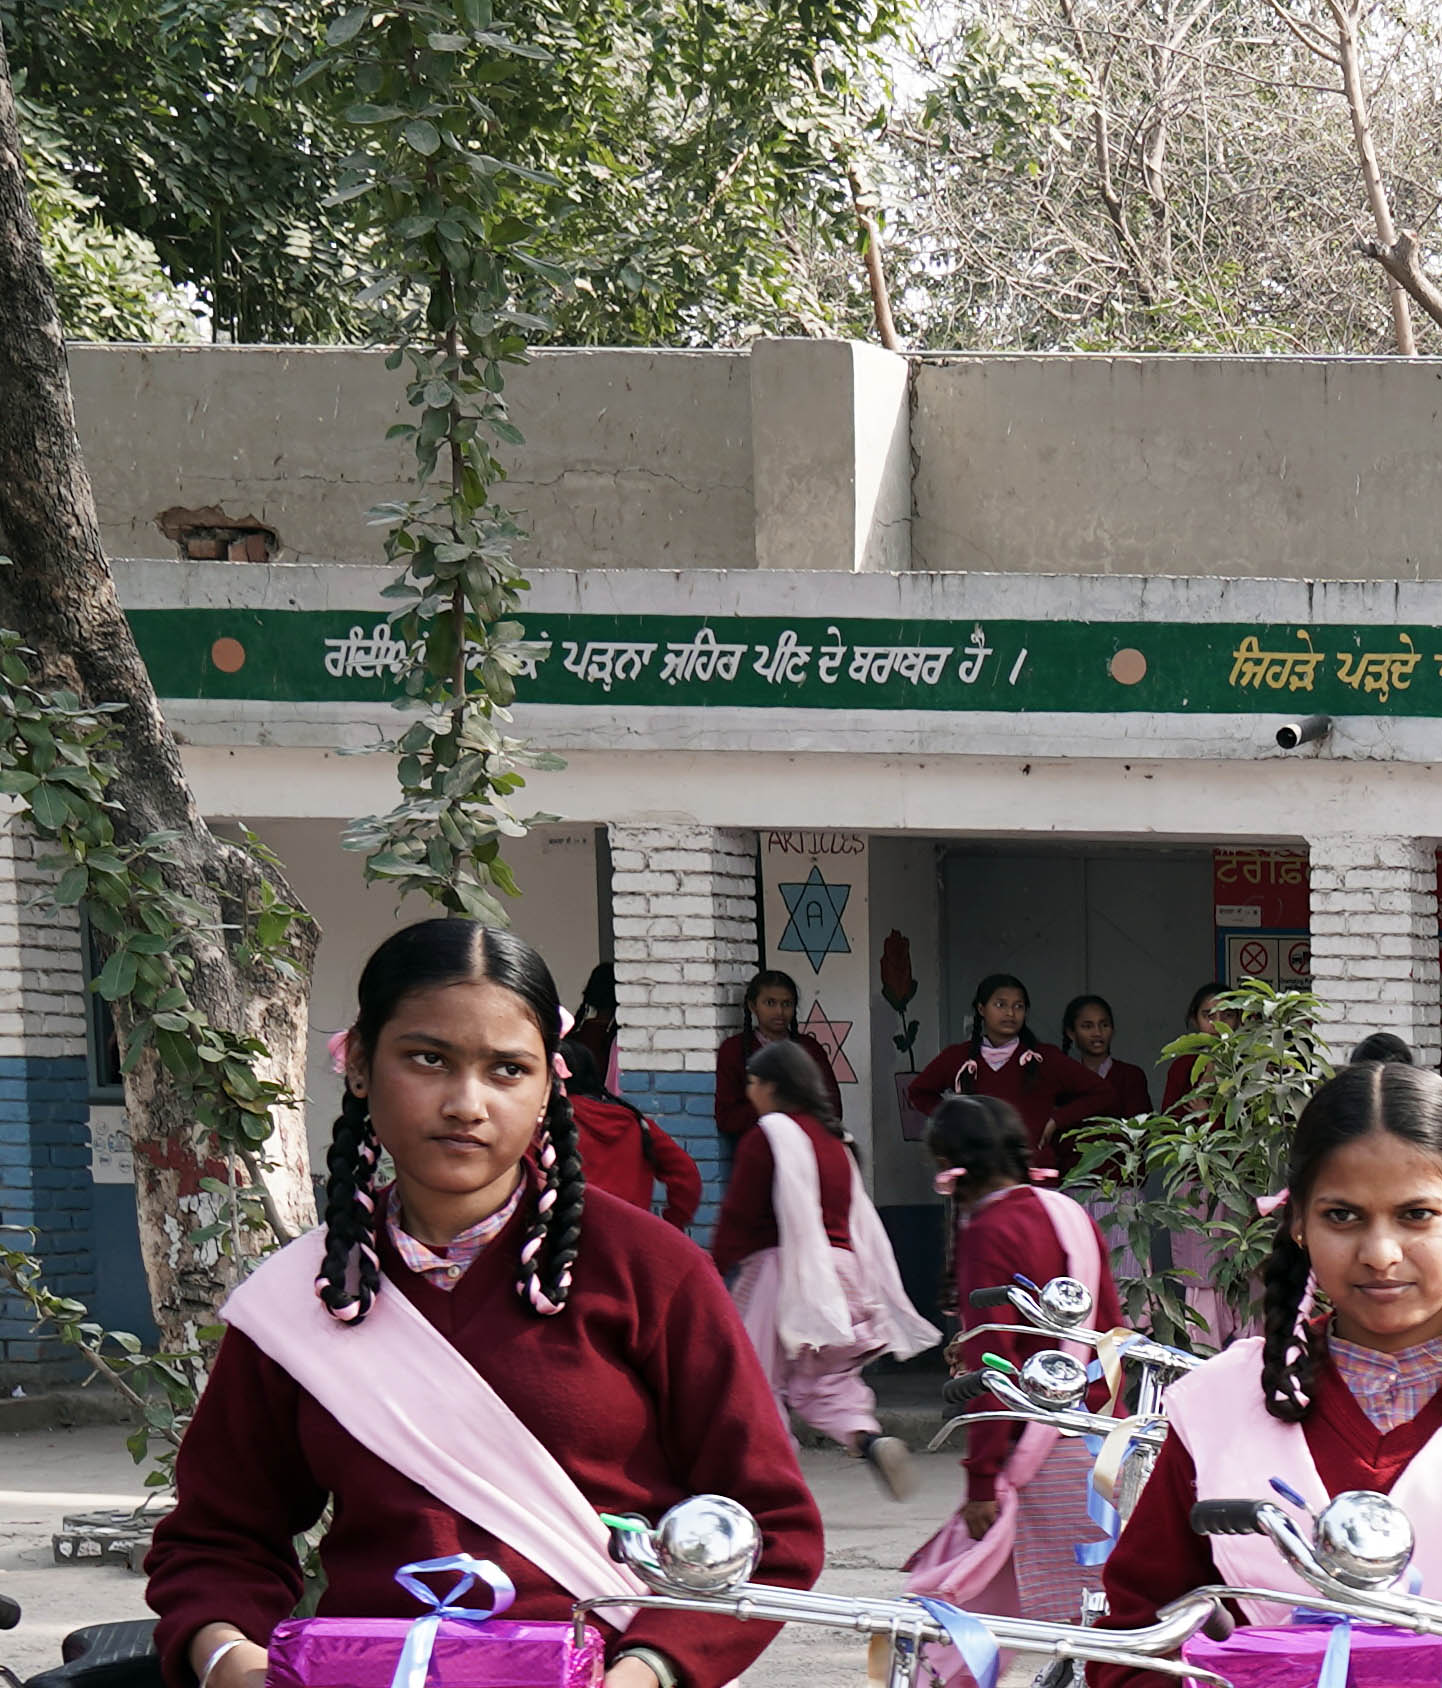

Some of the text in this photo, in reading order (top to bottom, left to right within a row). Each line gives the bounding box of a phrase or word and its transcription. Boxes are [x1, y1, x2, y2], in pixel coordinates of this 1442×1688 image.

[819, 626, 847, 684] ਦੇ
[849, 646, 953, 685] ਬਰਾਬਰ
[806, 901, 824, 929] A
